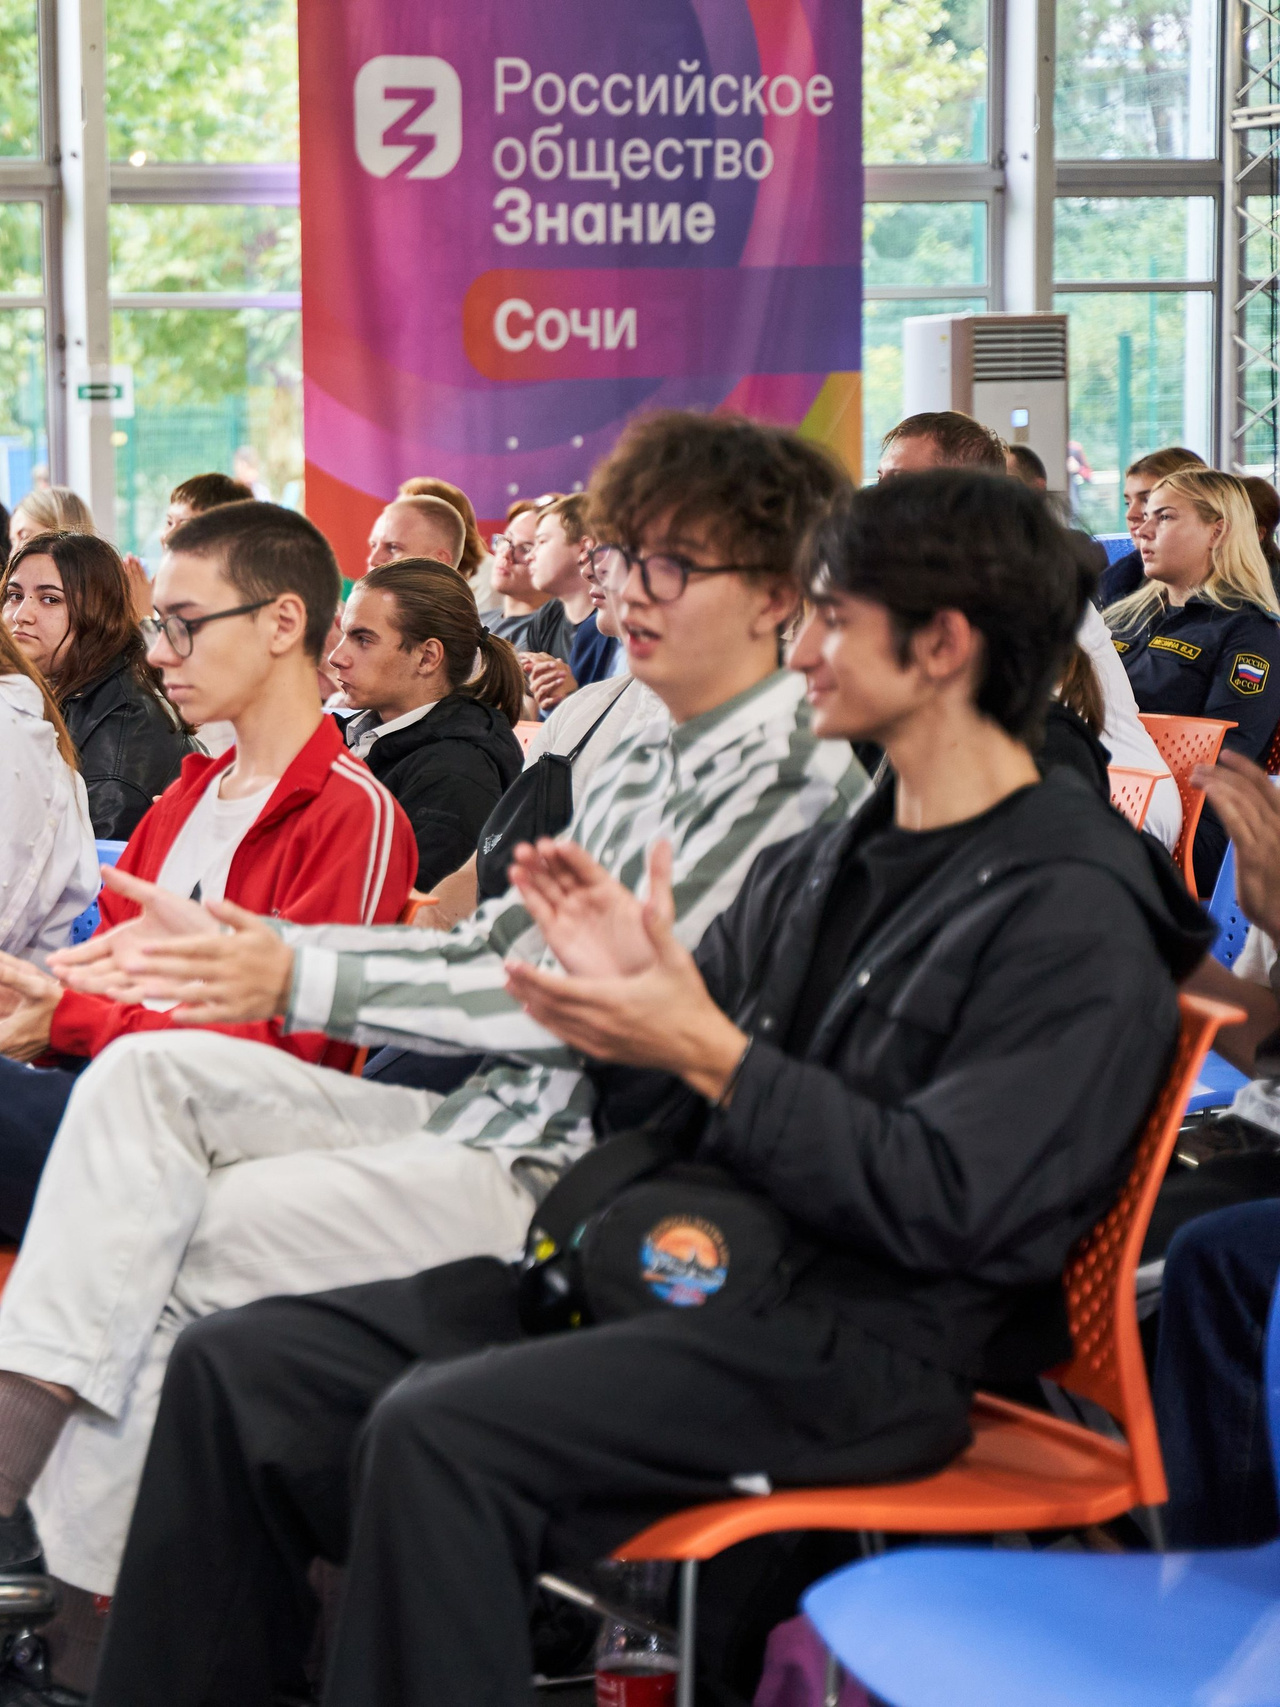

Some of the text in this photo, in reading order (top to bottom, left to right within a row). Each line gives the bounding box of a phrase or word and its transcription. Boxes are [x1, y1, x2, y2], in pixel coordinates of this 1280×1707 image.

[494, 57, 834, 116] Российское
[493, 123, 775, 188] общество
[493, 187, 717, 246] Знание
[493, 299, 638, 352] Сочи
[1234, 678, 1260, 691] ФССП
[1238, 656, 1268, 670] РОССИЯ
